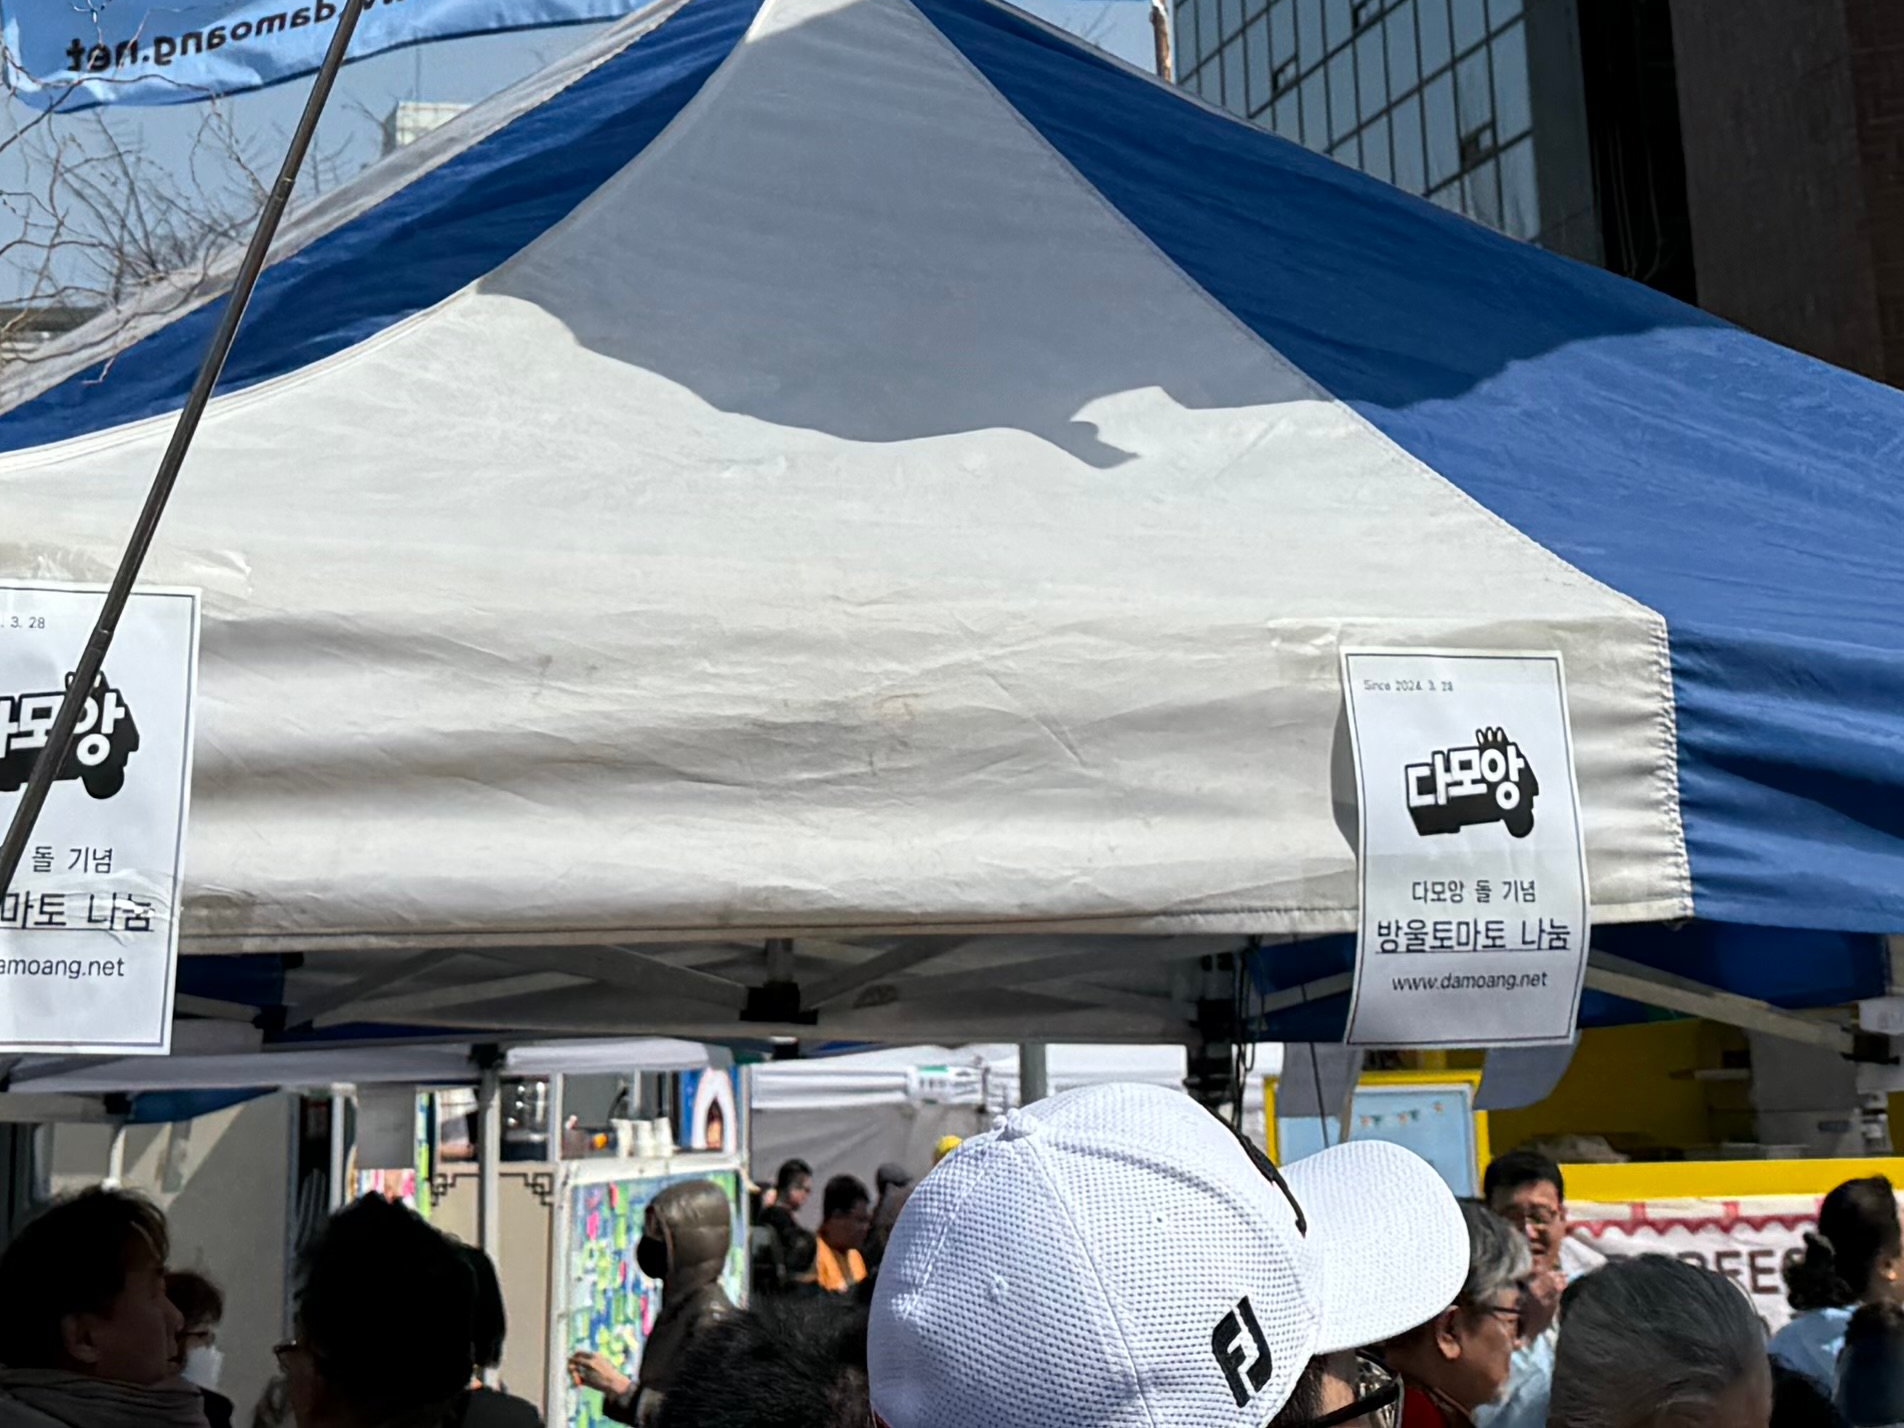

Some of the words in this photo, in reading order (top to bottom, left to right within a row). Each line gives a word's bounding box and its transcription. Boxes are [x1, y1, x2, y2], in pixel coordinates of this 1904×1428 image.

[28, 616, 46, 629] 28
[1407, 744, 1525, 810] 다모앙
[32, 845, 54, 873] 돌
[68, 846, 114, 874] 기념
[1412, 879, 1465, 904] 다모앙
[1475, 879, 1492, 903] 돌
[1502, 879, 1536, 903] 기념
[1377, 918, 1506, 953] 방울토마토
[1522, 917, 1571, 951] 나눔
[1392, 972, 1548, 991] www.damoang.net
